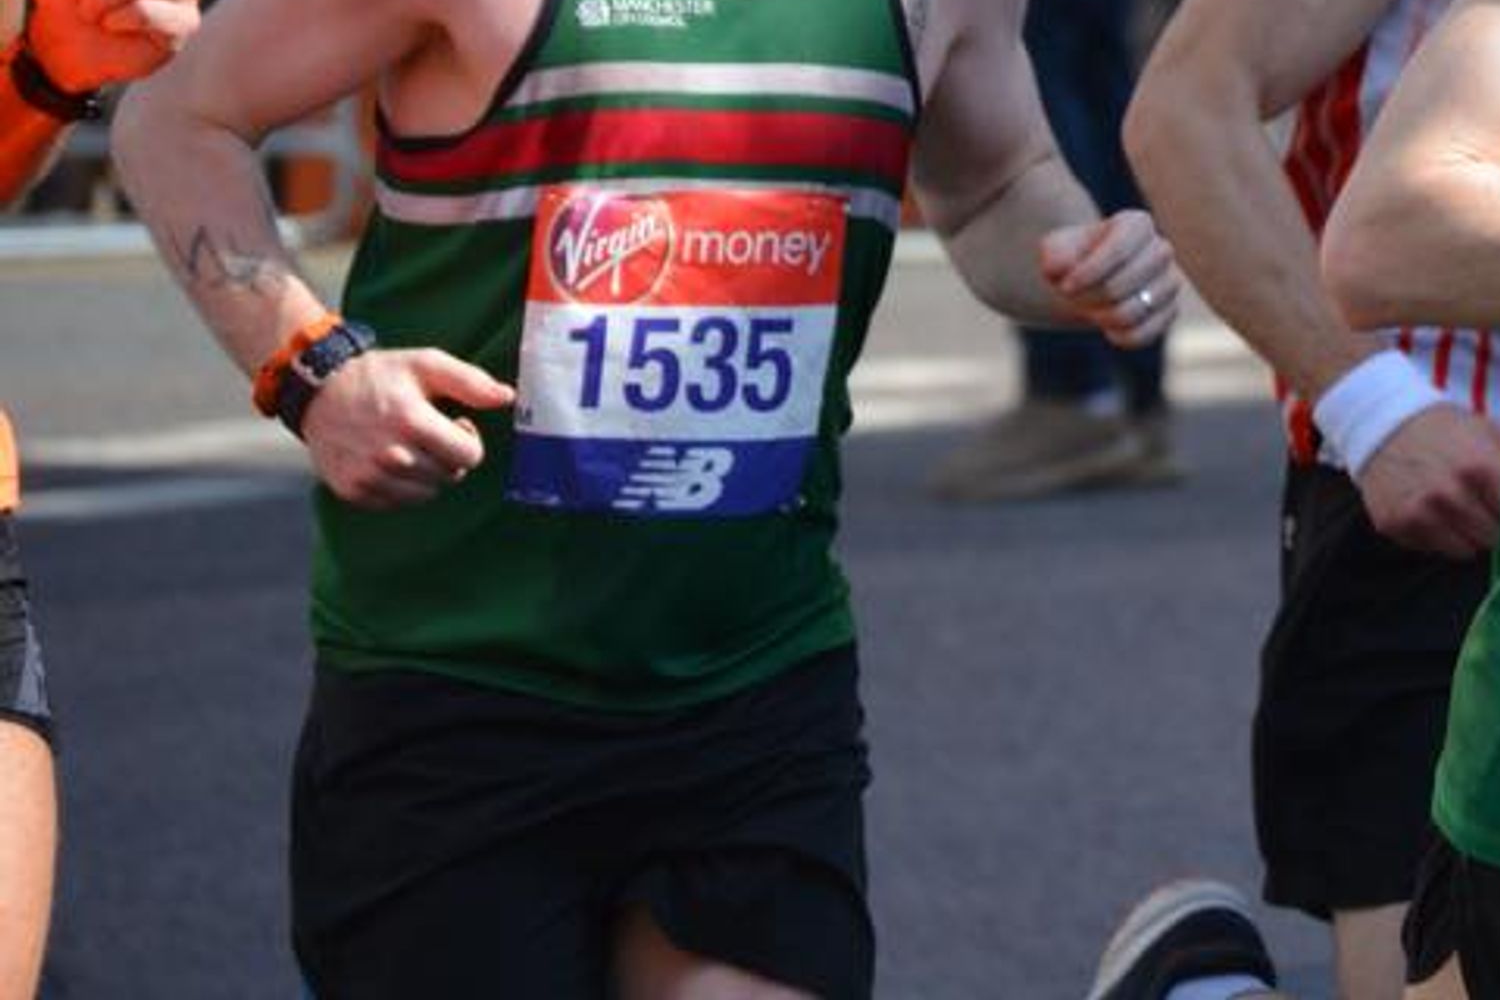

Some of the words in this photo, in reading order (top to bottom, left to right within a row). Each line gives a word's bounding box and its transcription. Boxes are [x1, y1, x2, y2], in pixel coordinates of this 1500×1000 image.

[555, 192, 668, 295] Virgin
[683, 226, 832, 275] money
[567, 315, 793, 413] 1535
